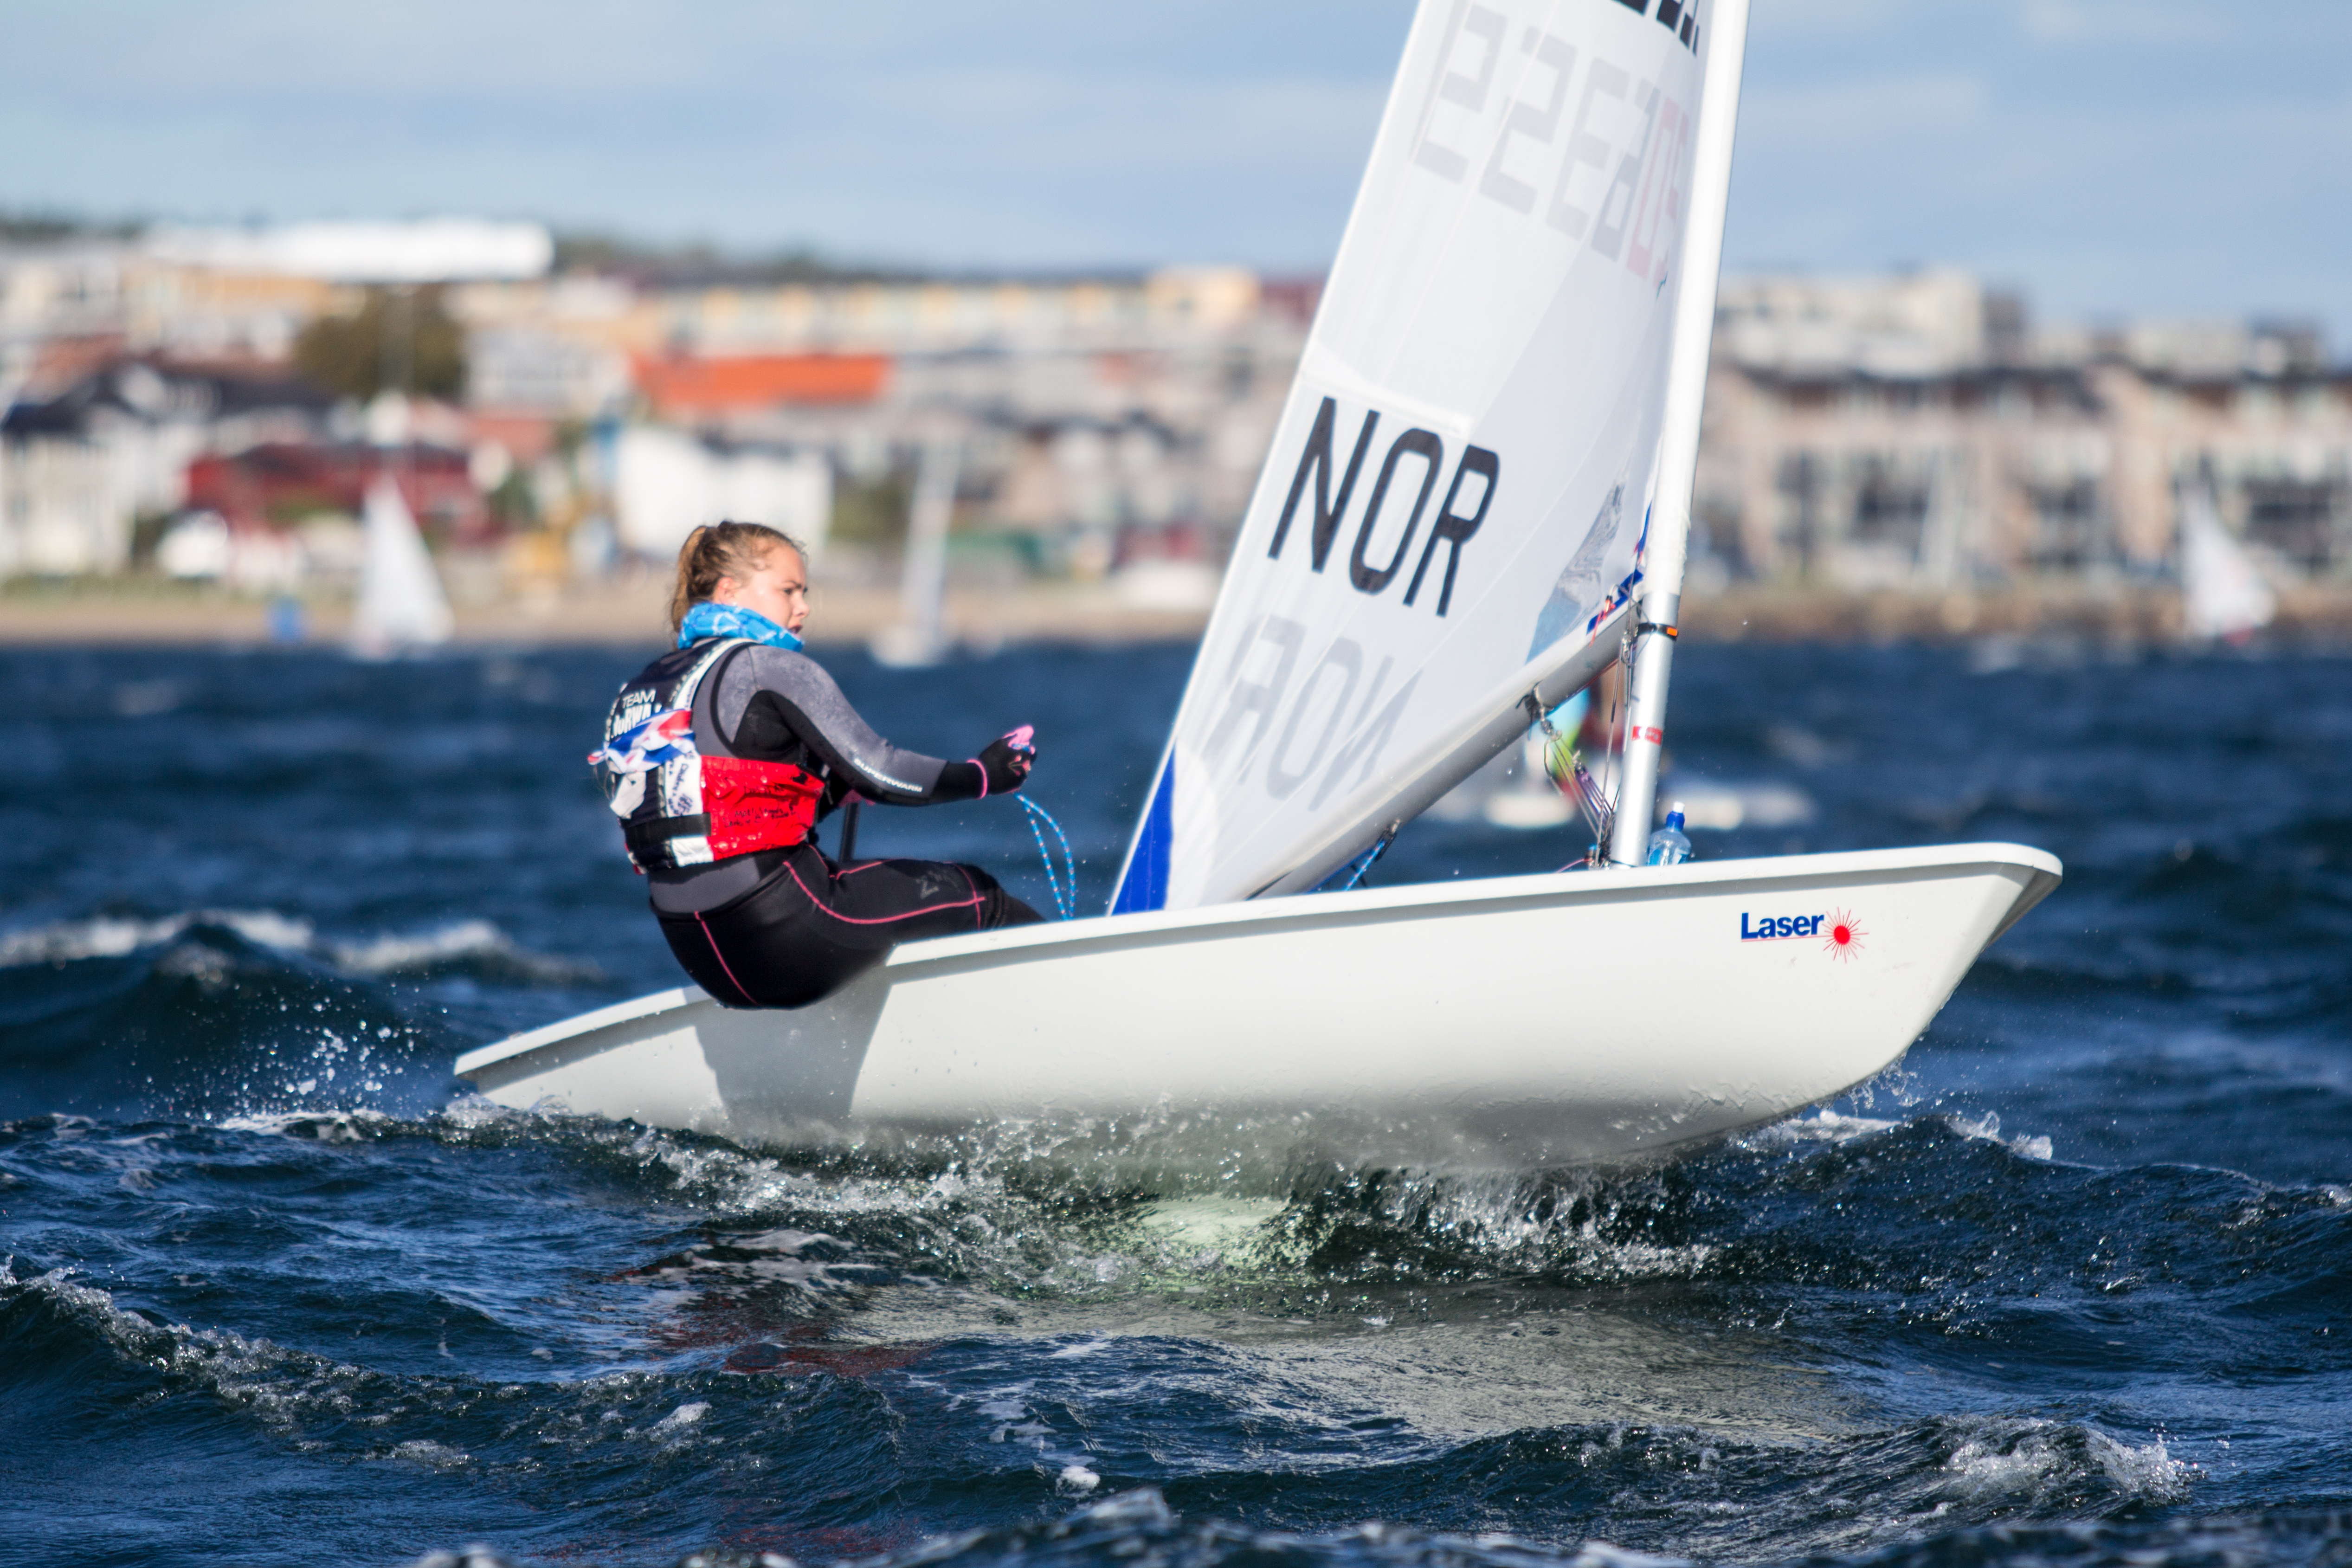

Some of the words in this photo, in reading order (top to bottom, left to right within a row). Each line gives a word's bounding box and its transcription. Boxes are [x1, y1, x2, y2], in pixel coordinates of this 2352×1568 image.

[1267, 396, 1500, 618] NOR
[623, 689, 657, 708] TEAM
[854, 758, 922, 792] SUPERWARM
[1741, 912, 1824, 939] Laser
